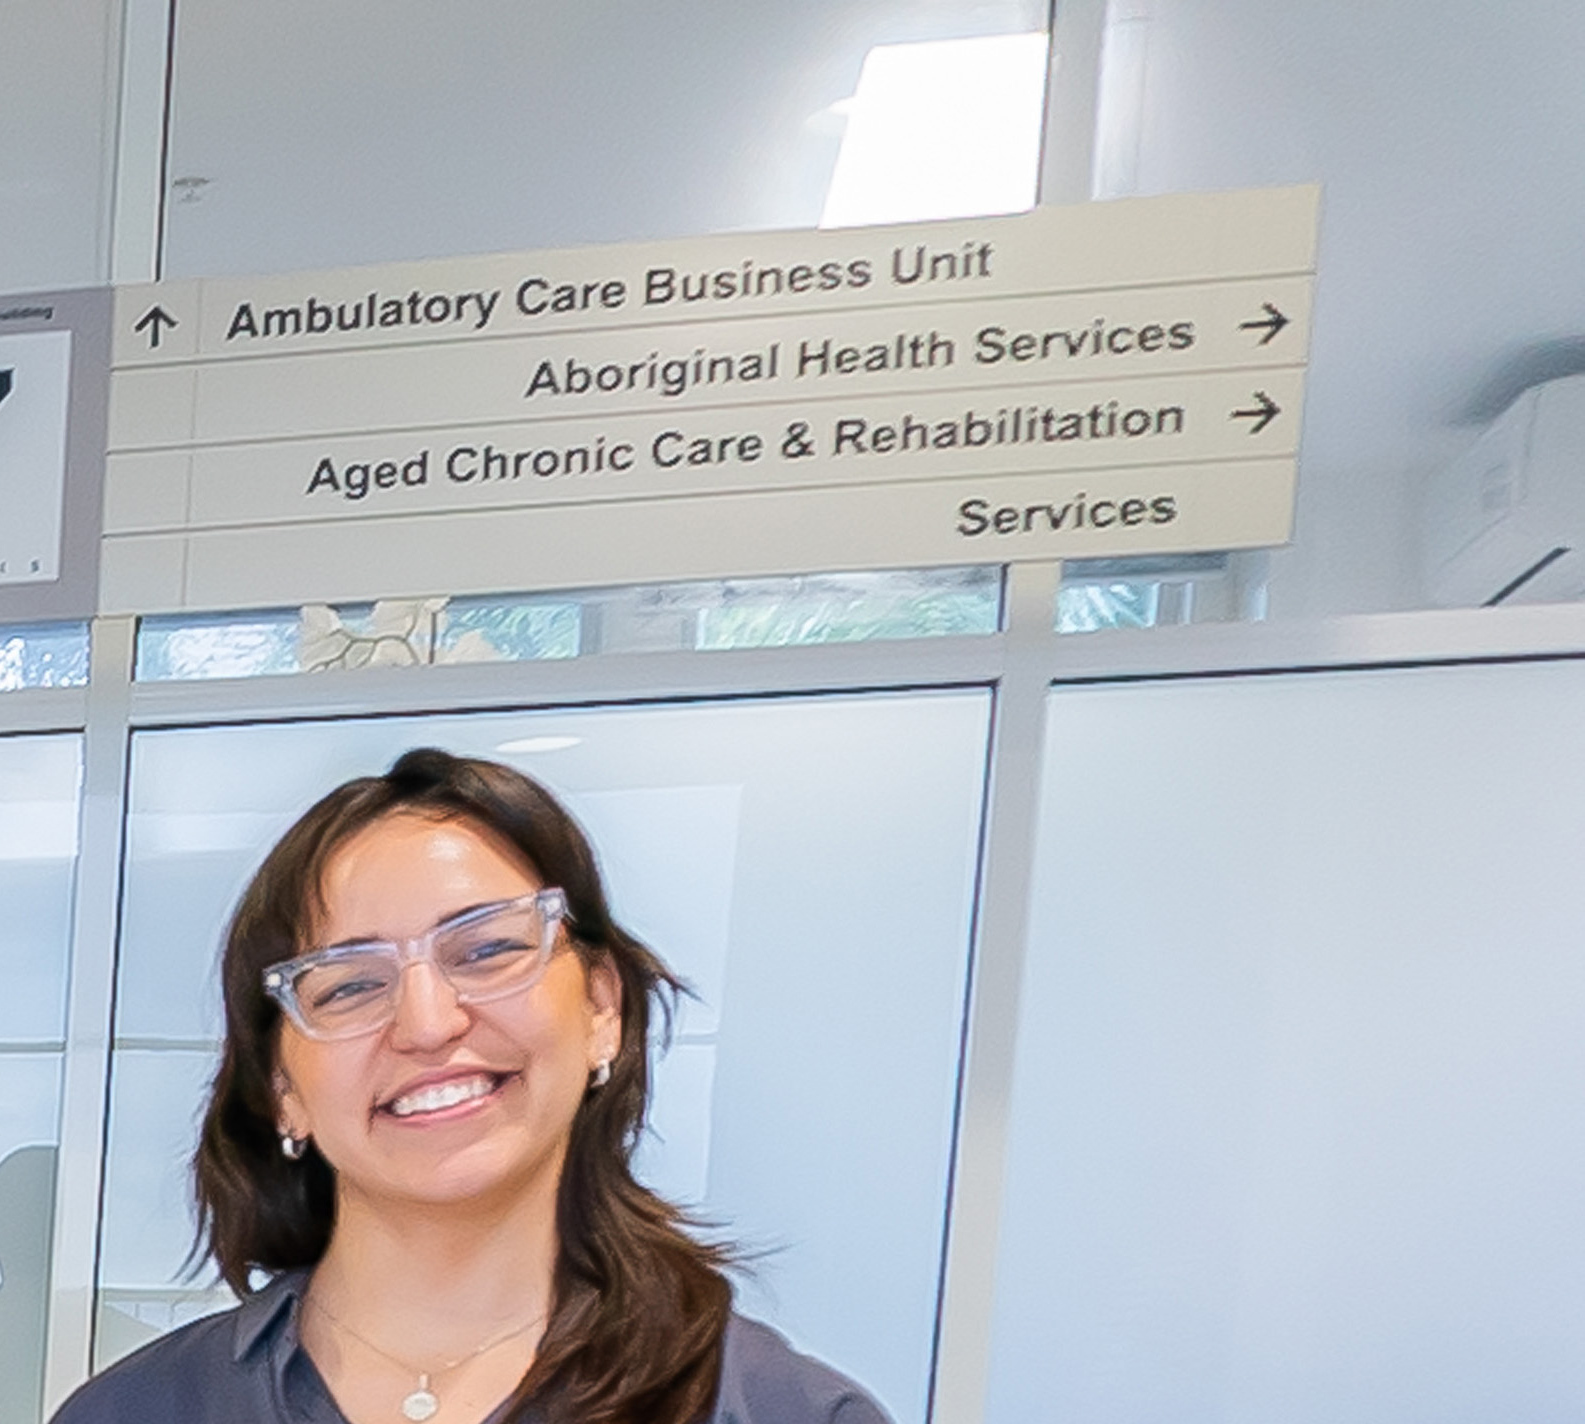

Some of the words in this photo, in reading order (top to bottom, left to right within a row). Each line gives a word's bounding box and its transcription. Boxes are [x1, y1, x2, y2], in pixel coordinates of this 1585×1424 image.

[225, 289, 502, 341] Ambulatory
[515, 278, 628, 316] Care
[642, 260, 873, 307] Business
[890, 242, 995, 285] Unit
[523, 341, 781, 398] Aboriginal
[794, 331, 957, 380] Health
[974, 318, 1196, 366] Services
[306, 450, 431, 502] Aged
[444, 435, 636, 484] Chronic
[650, 430, 764, 470] Care
[780, 420, 817, 460] &
[831, 399, 1187, 457] Rehabilitation
[955, 490, 1180, 538] Services
